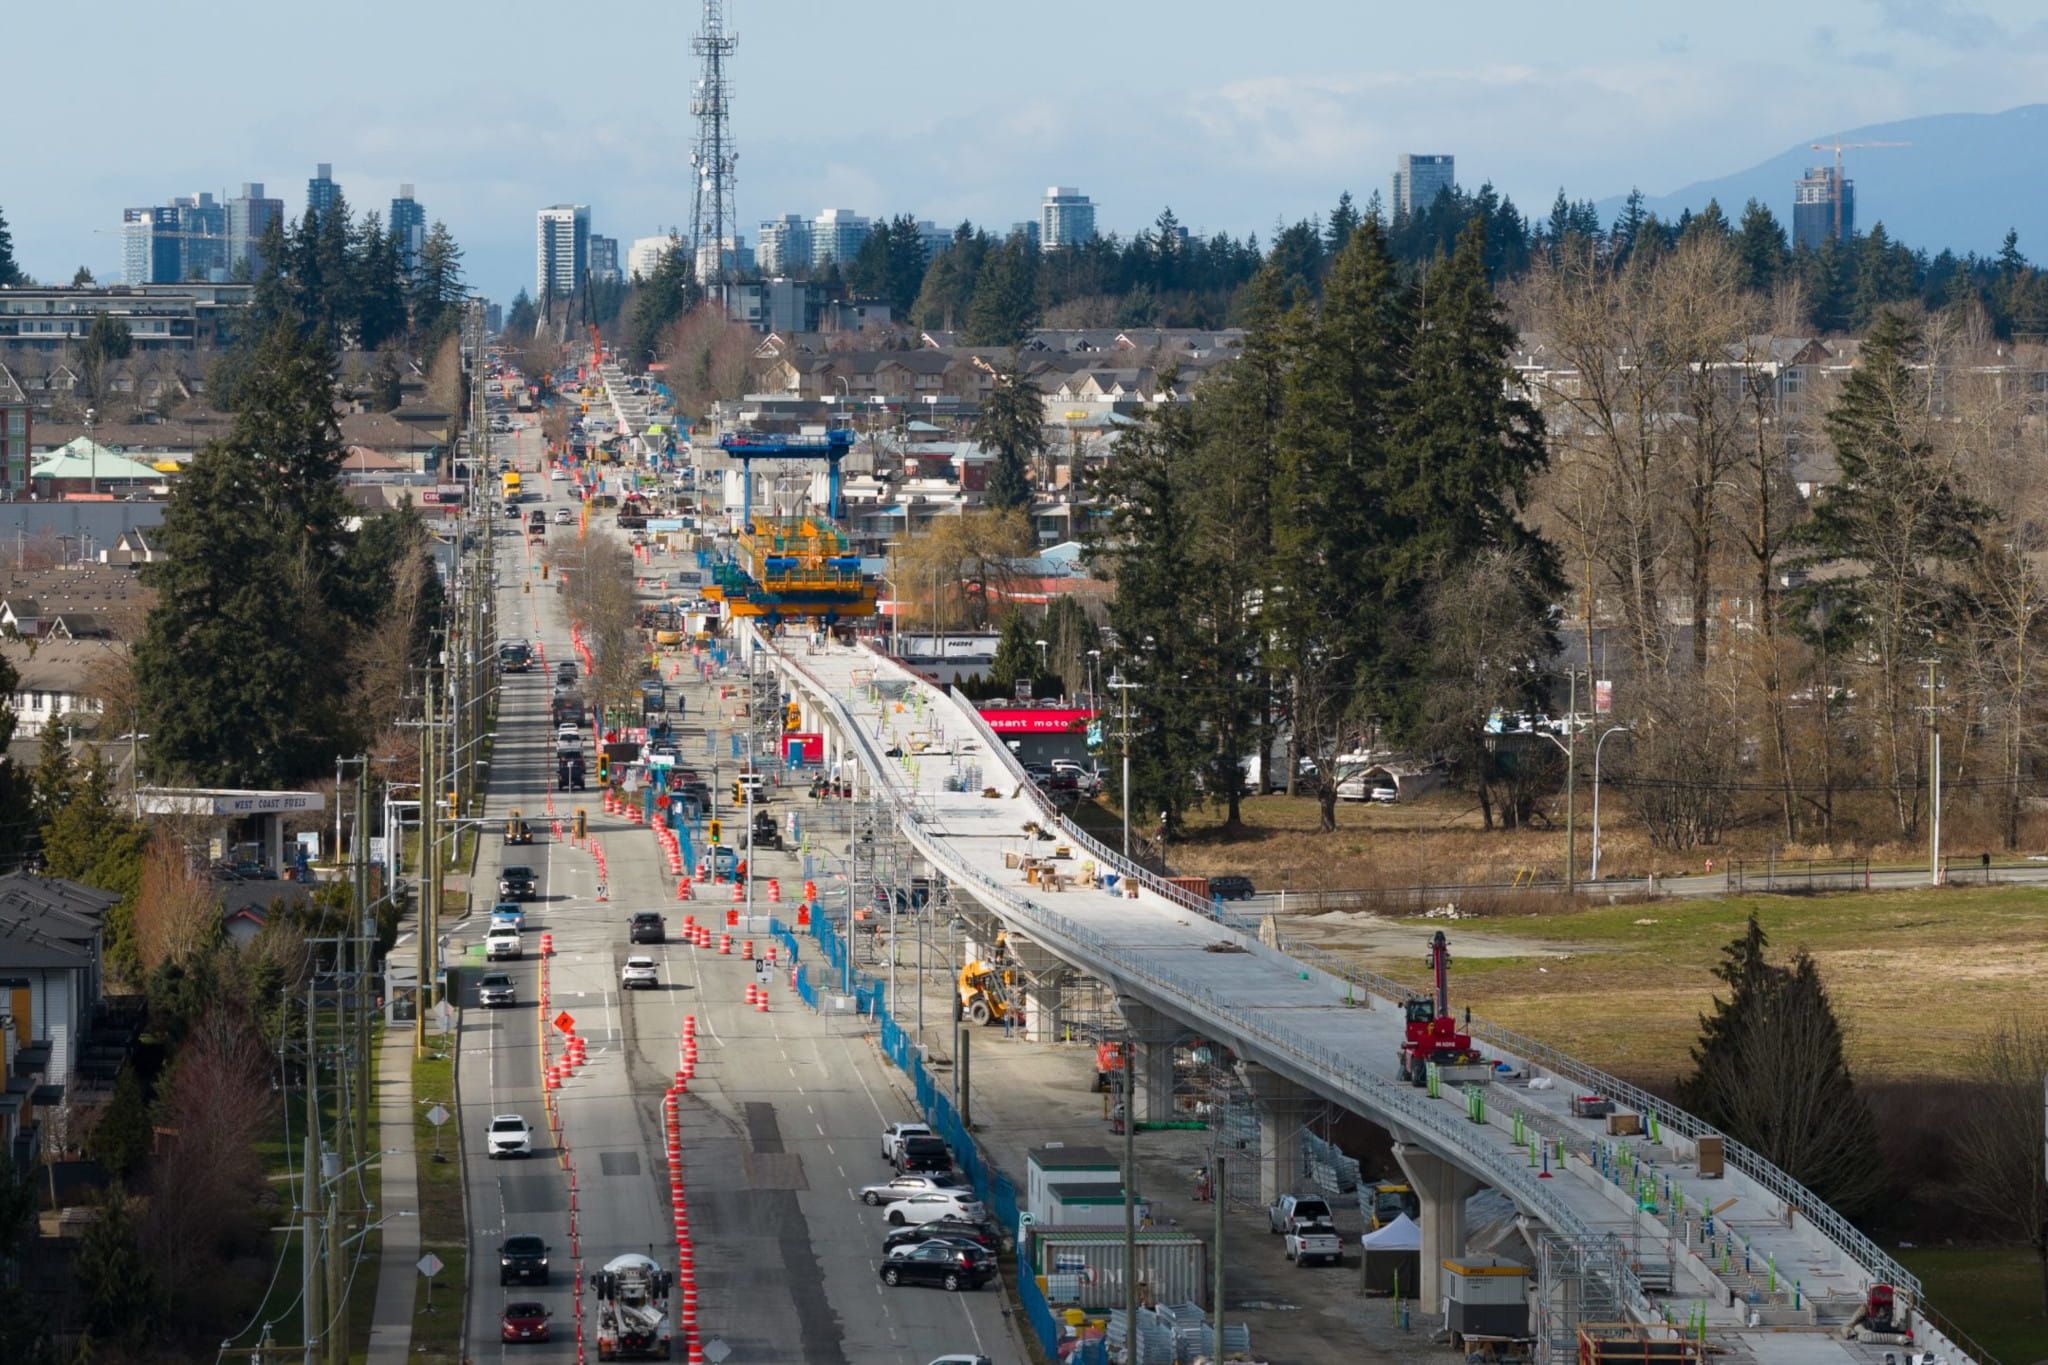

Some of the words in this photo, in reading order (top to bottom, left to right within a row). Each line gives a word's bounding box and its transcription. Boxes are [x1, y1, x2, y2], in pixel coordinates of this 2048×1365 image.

[235, 800, 253, 809] WEST
[259, 799, 280, 808] COAST
[285, 798, 306, 807] FUELS
